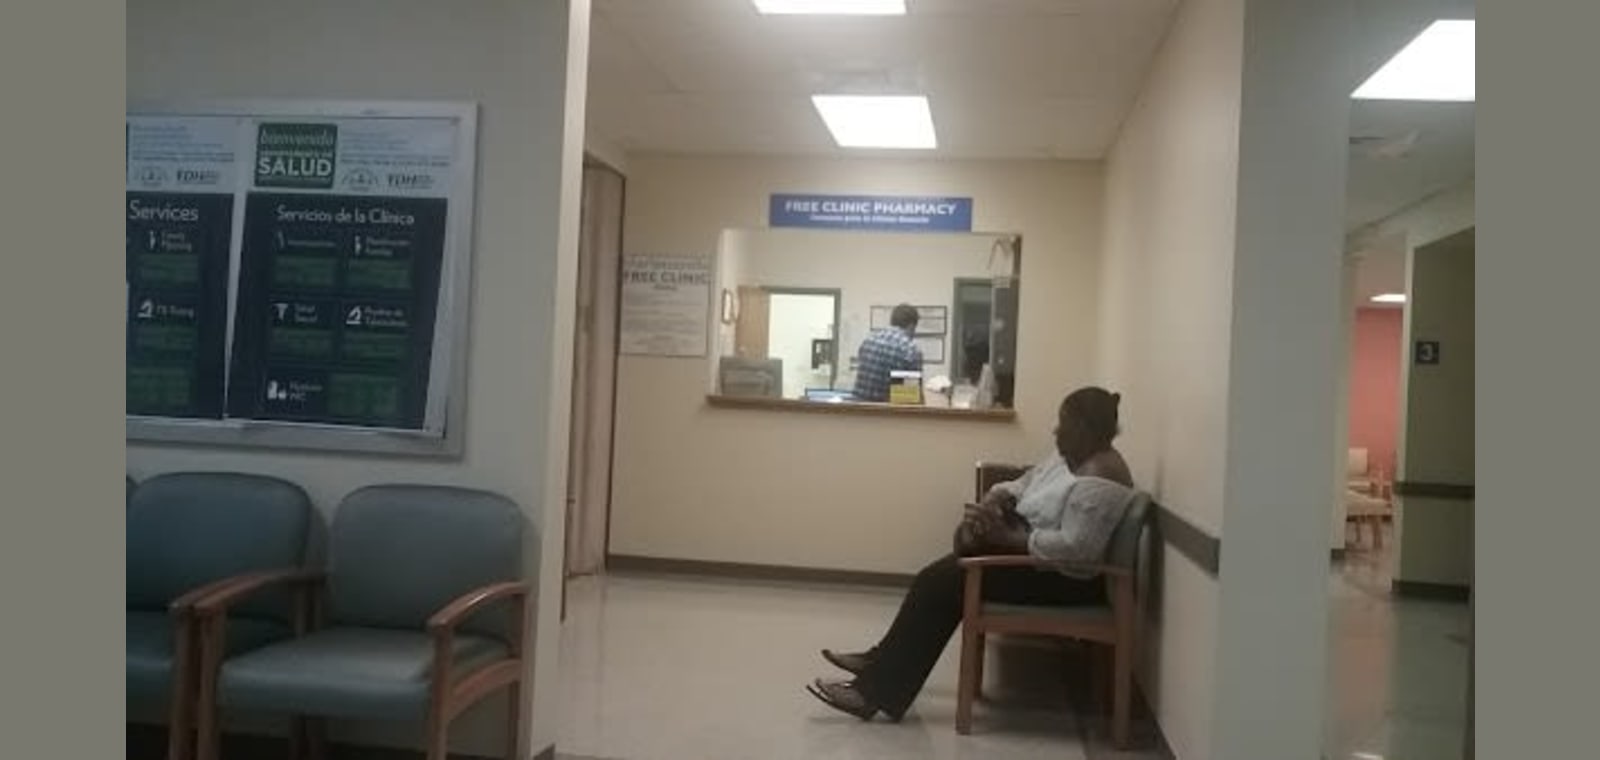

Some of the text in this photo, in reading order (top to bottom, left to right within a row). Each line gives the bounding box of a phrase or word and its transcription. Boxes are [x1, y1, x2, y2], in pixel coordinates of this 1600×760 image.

[257, 157, 332, 176] SALUD
[128, 199, 199, 222] Services
[276, 204, 333, 222] Servicios
[335, 207, 351, 223] de
[354, 207, 366, 223] la
[784, 200, 957, 216] FREE CLINIC PHARMACY
